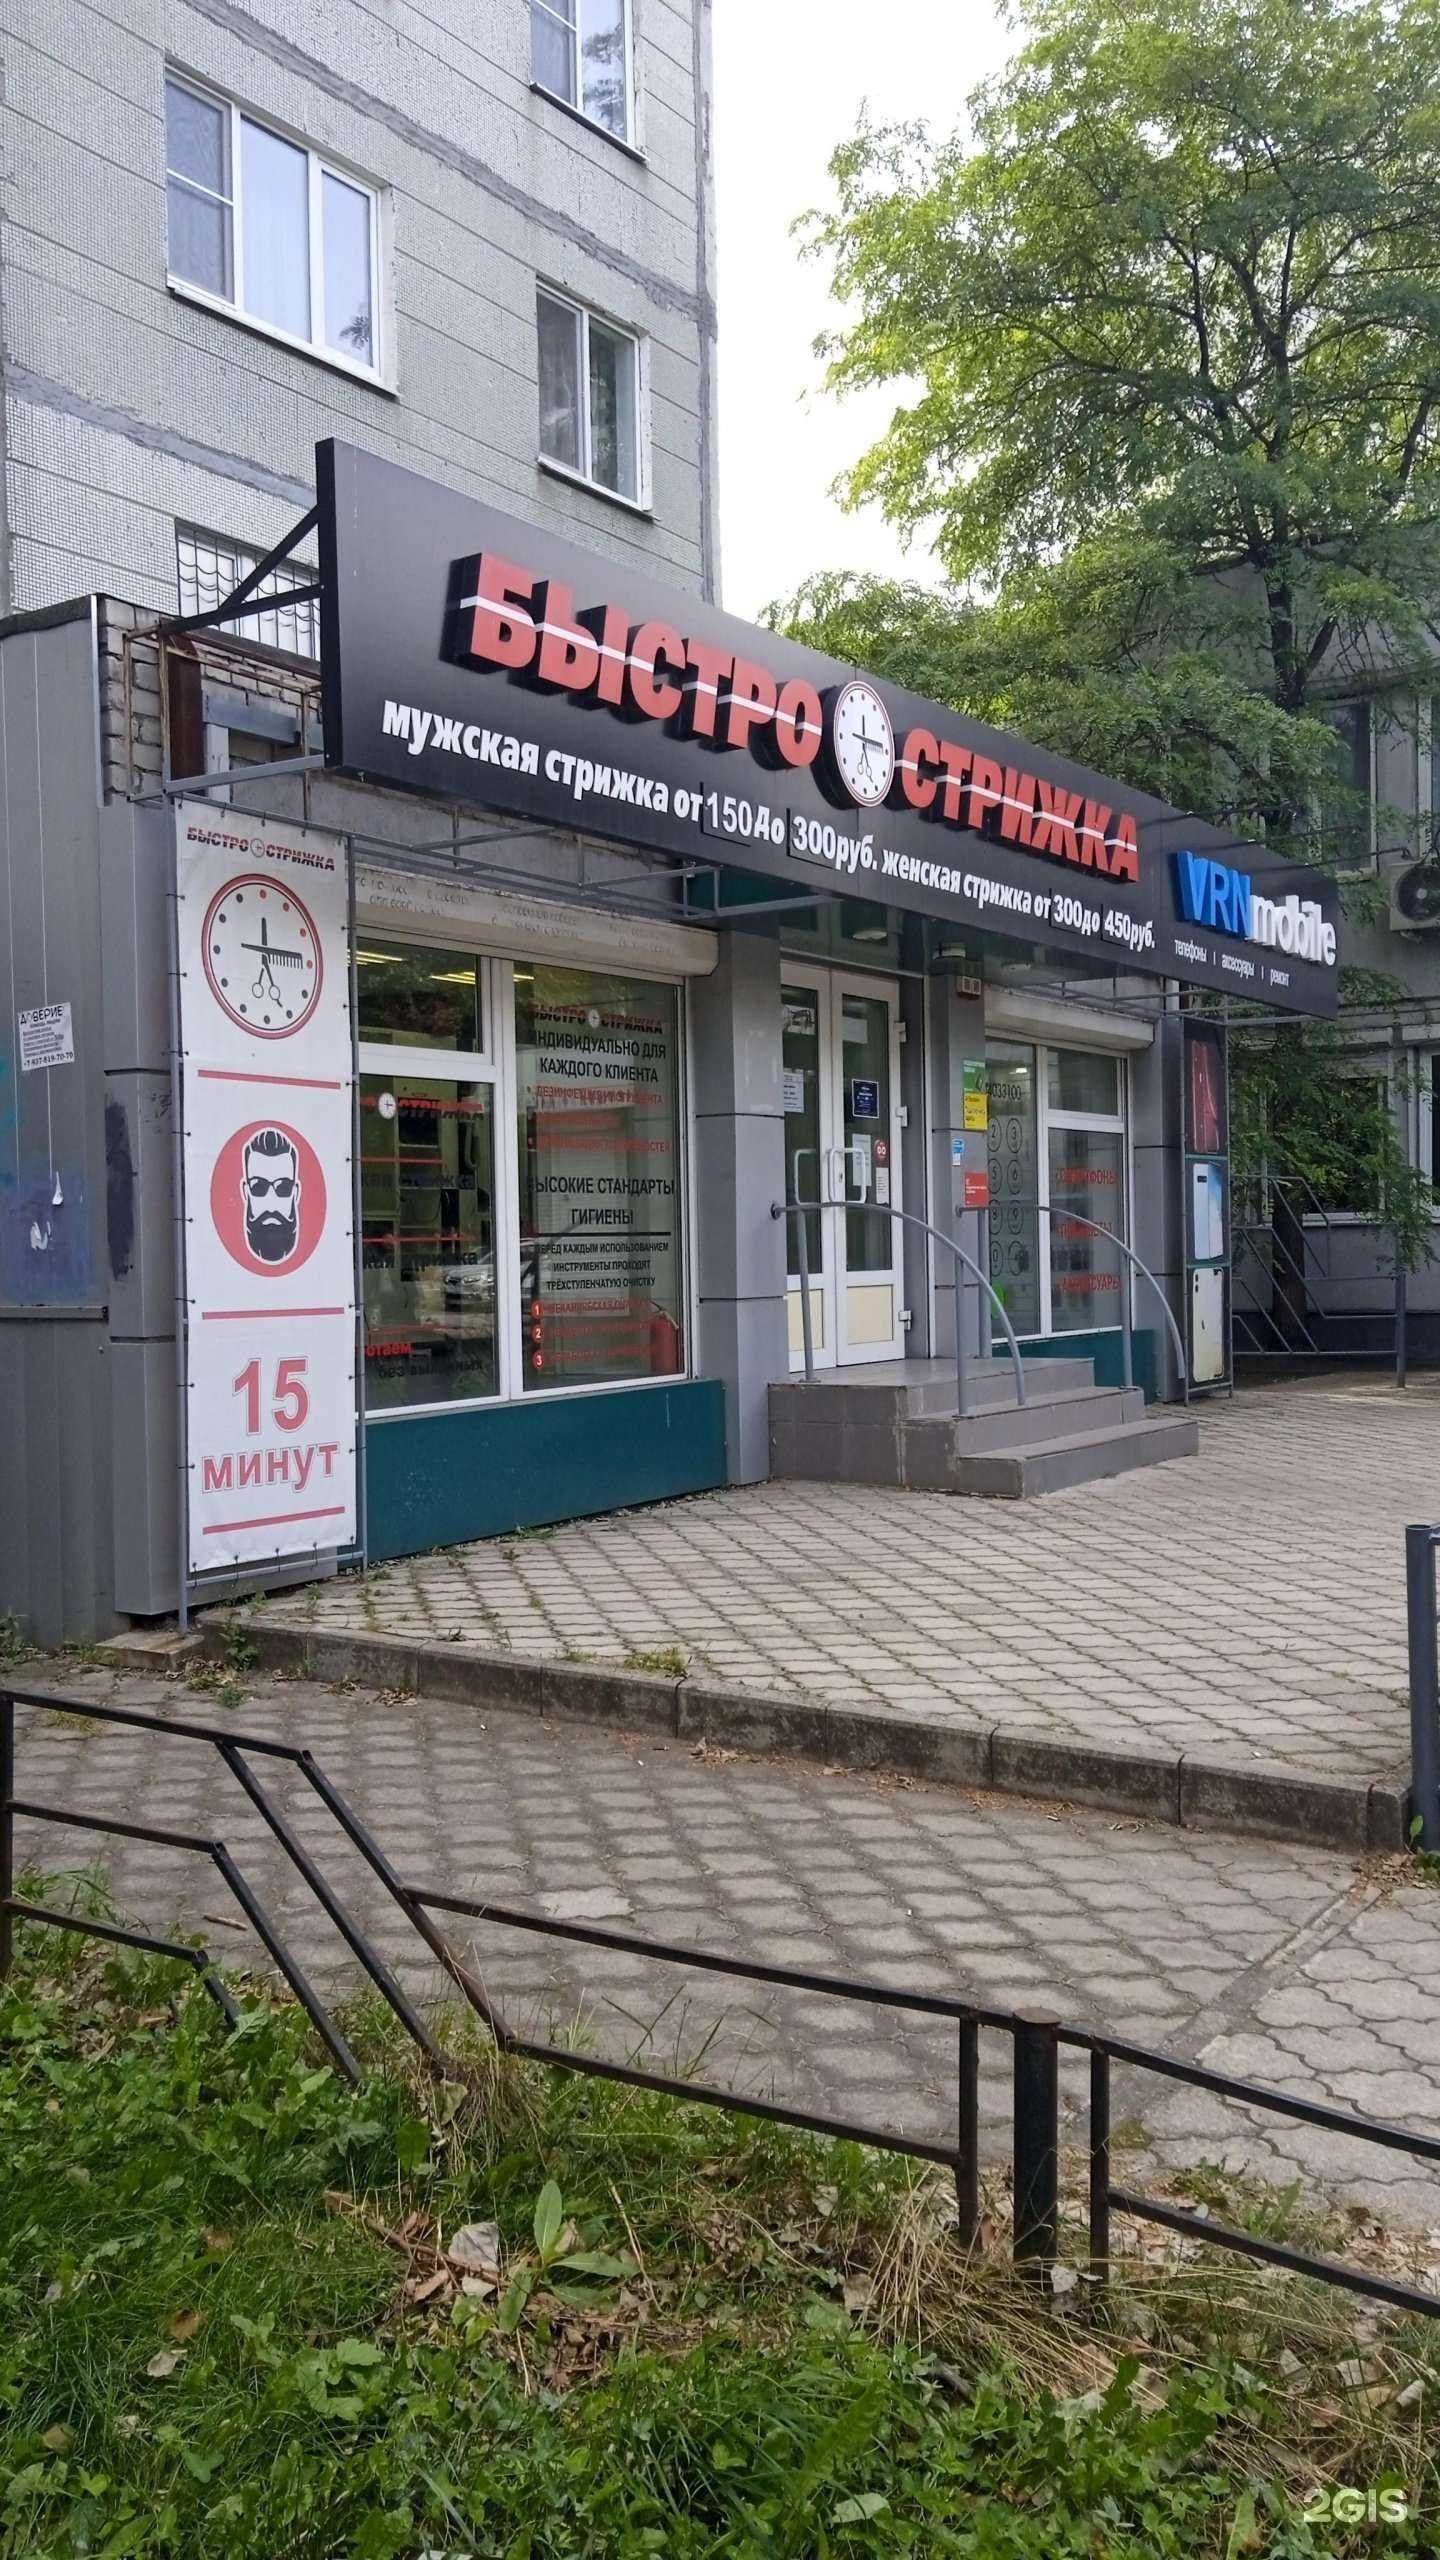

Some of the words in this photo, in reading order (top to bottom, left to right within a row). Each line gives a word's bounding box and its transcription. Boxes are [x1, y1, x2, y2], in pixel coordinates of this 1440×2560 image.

[469, 553, 823, 768] БЫСТРО
[900, 727, 1140, 883] СТРИЖКА
[382, 700, 540, 776] мужская
[544, 749, 670, 814] стрижка
[673, 788, 703, 823] от
[793, 816, 877, 874] 300руб.
[881, 848, 961, 895] женская
[963, 873, 1031, 915] стрижка
[1034, 894, 1051, 920] от
[1104, 910, 1155, 952] 450руб.
[186, 827, 250, 852] БЫСТРО
[265, 844, 336, 872] СТРИЖКА
[1174, 939, 1207, 964] телефоны
[1270, 968, 1290, 987] ремонт
[537, 1030, 640, 1057] НДИВИДУАЛЬНО
[643, 1042, 667, 1060] ДЛЯ
[540, 1057, 602, 1079] КАЖДОГО
[605, 1064, 659, 1083] КЛИЕНТА
[529, 1175, 594, 1195] ЫСОКИЕ
[597, 1178, 674, 1197] СТАНДАРТЫ
[571, 1208, 633, 1225] ГИГИЕНЫ
[563, 1242, 599, 1255] КАЖДЫМ
[600, 1241, 669, 1253] ИСПОЛЬЗОВАНИЕМ
[553, 1261, 611, 1273] ИНСТРУМЕНТЫ
[612, 1259, 651, 1271] ПРОХОДЯТ
[622, 1276, 656, 1288] ОЧИСТКУ
[364, 1342, 413, 1358] отаем
[233, 1356, 311, 1435] 15
